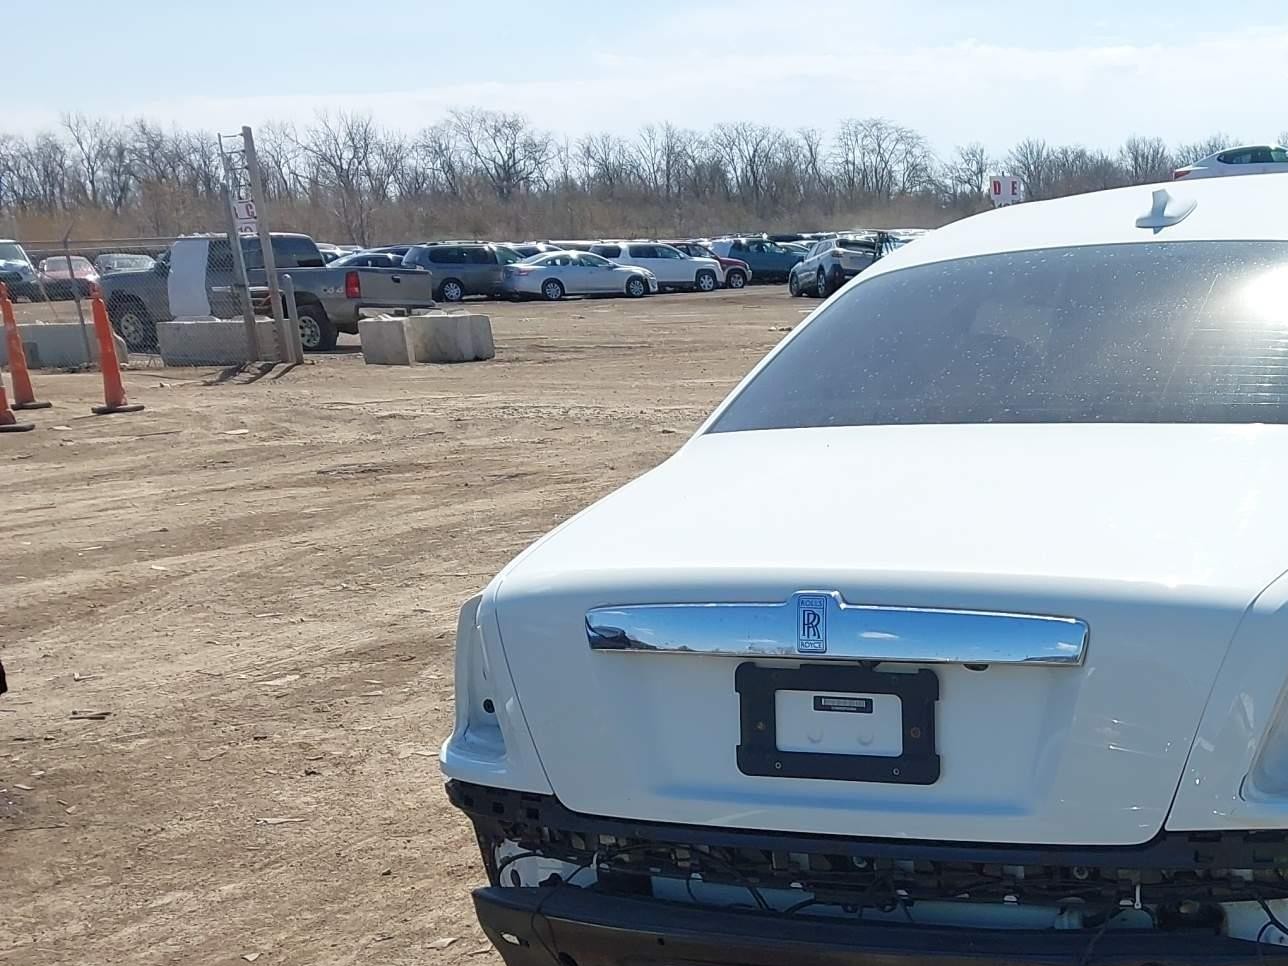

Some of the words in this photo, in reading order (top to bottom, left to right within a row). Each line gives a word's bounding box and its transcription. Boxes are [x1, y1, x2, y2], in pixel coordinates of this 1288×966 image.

[993, 180, 1002, 196] D
[1011, 180, 1018, 196] E
[800, 641, 822, 649] ROYCE
